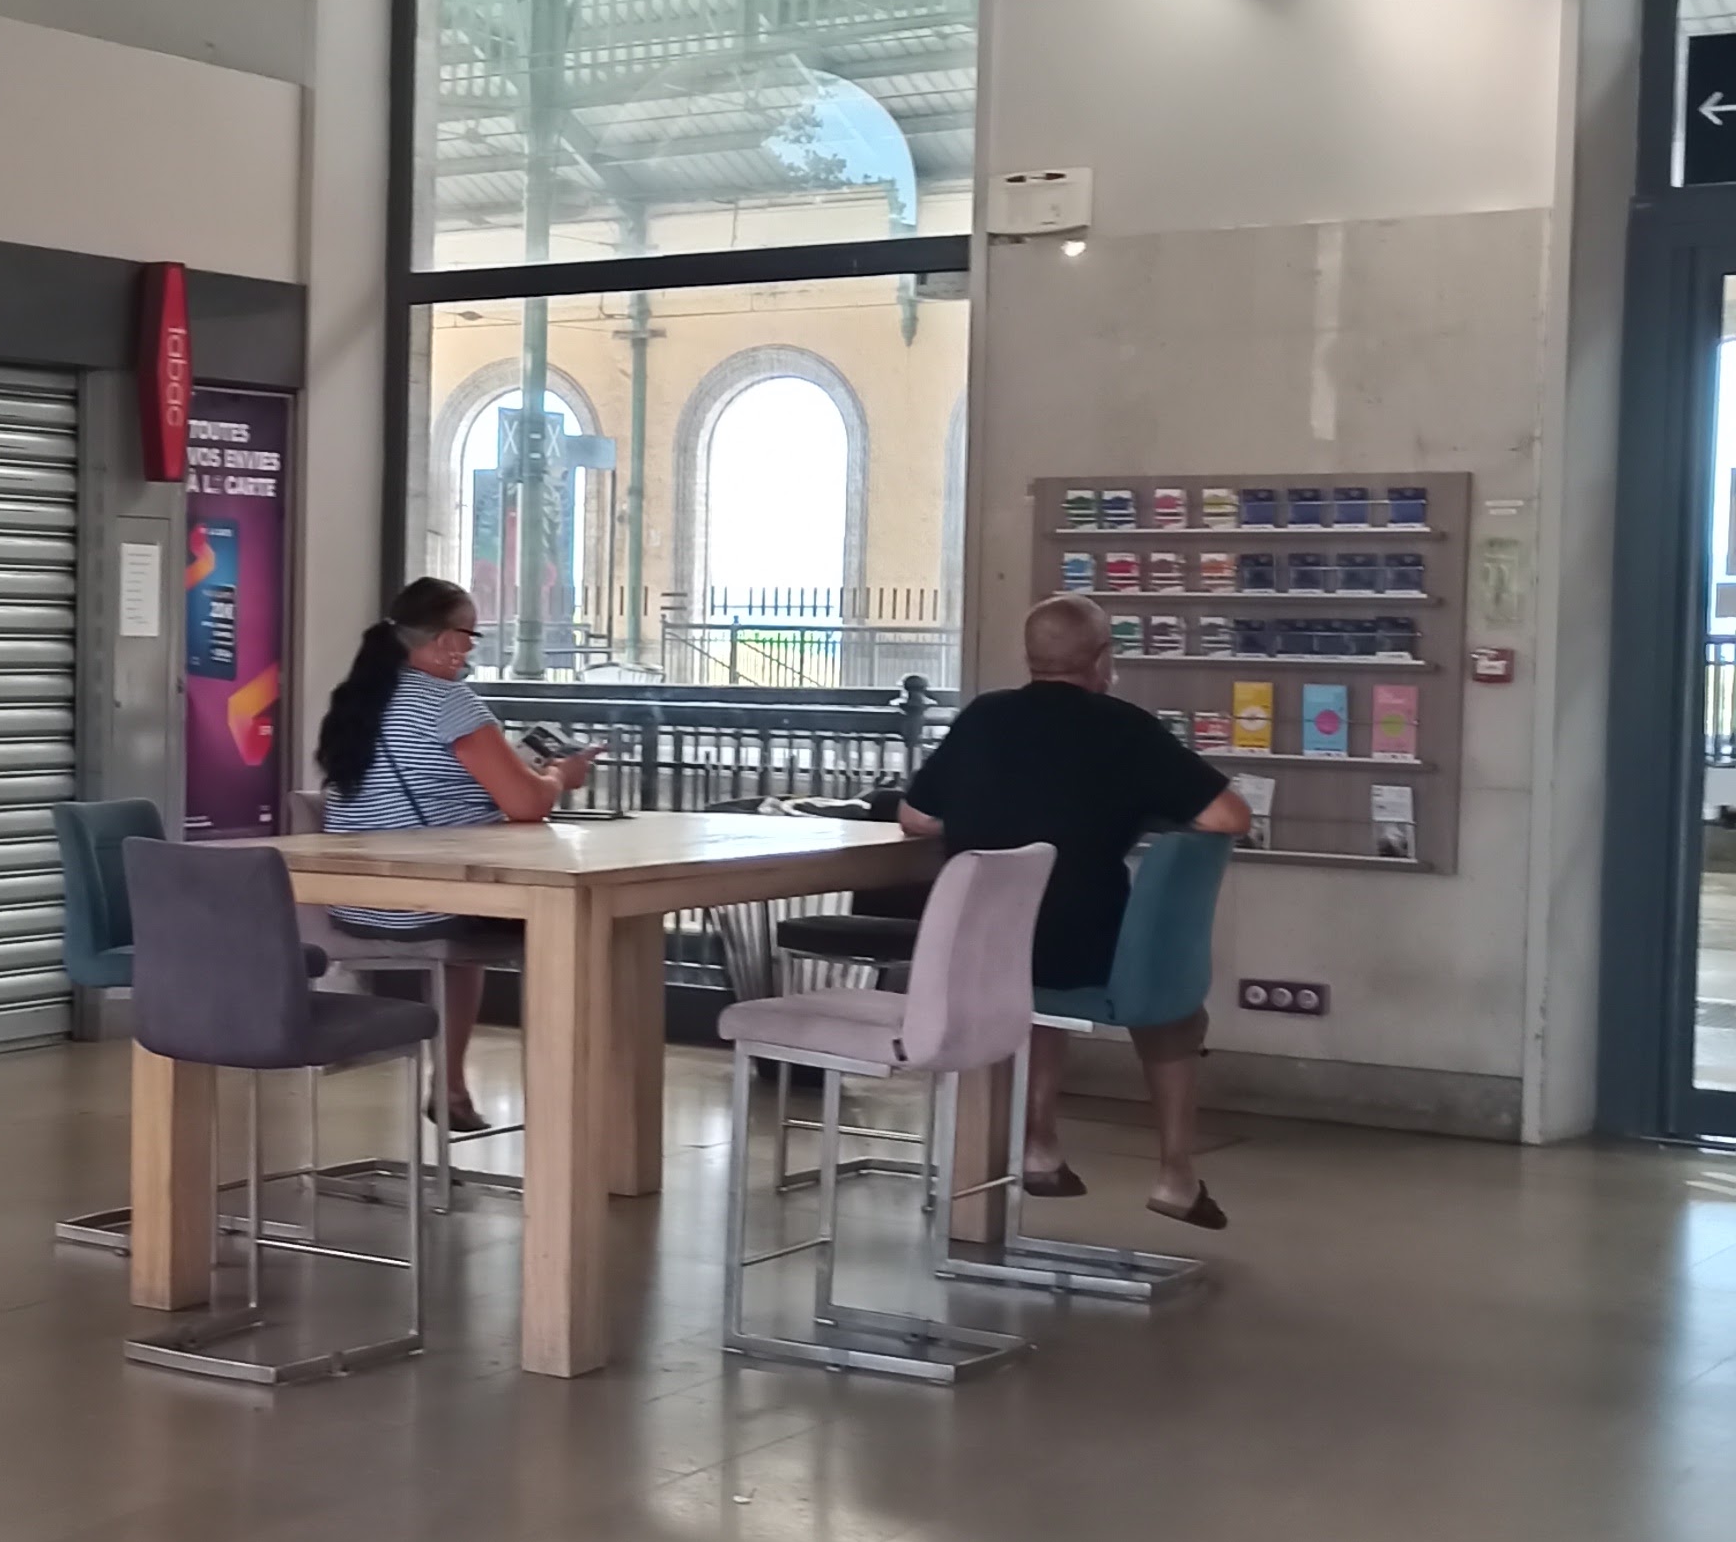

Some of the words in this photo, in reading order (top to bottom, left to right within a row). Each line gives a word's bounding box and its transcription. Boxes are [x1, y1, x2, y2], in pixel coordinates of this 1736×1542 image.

[166, 327, 188, 427] tabac
[187, 419, 251, 443] TOUTES
[186, 445, 222, 468] VOS
[223, 448, 281, 471] ENVIES
[224, 475, 277, 498] CARTE
